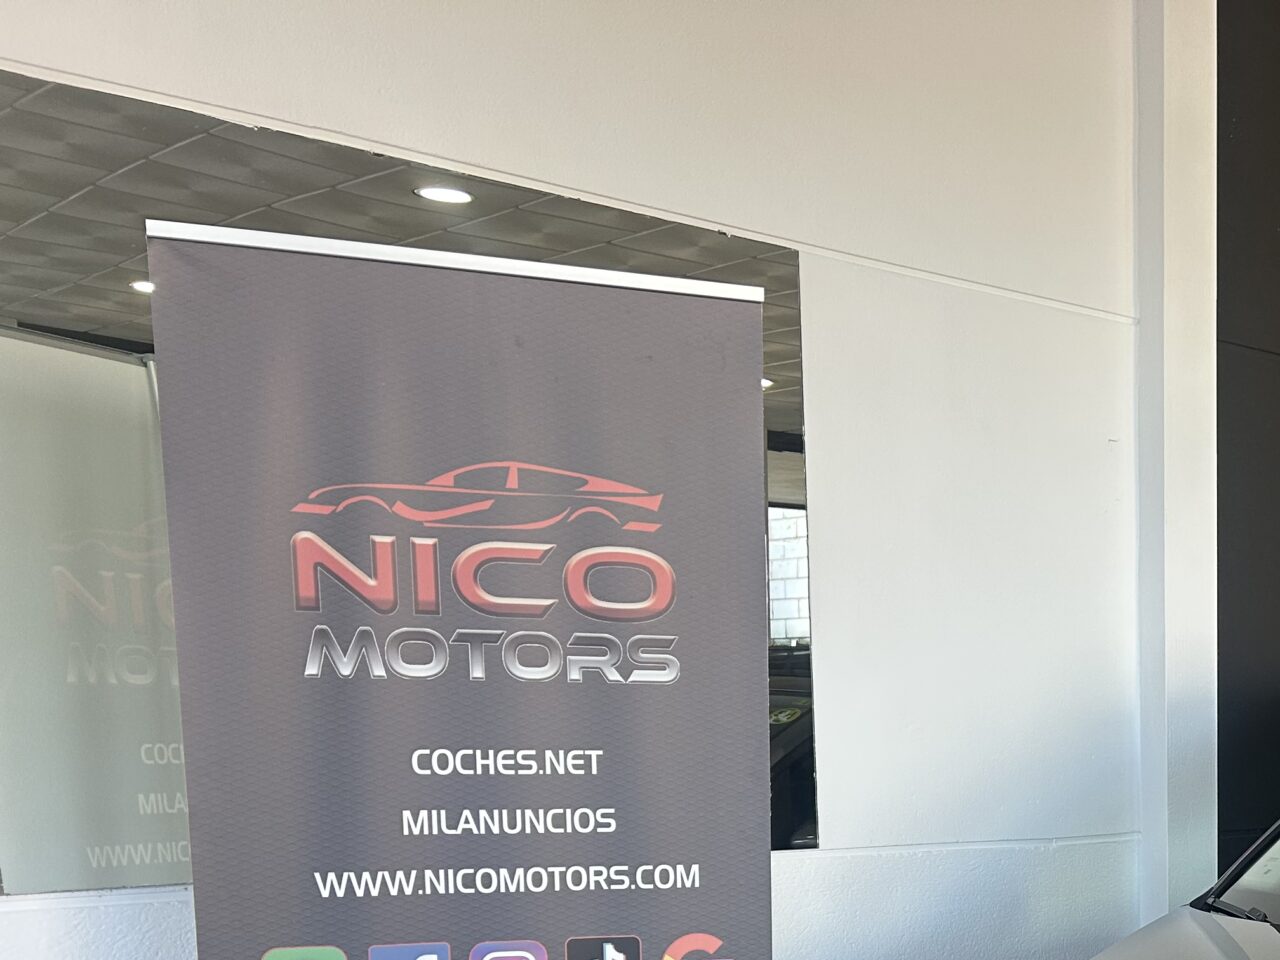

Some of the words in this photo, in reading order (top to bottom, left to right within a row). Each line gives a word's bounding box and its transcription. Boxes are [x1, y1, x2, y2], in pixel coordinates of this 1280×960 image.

[290, 530, 677, 624] NICO
[304, 625, 680, 685] MOTORS
[140, 743, 185, 765] COC
[411, 748, 603, 776] COCHES.NET
[401, 807, 617, 836] MILANUNCIOS
[313, 863, 700, 898] WWW.NICOMOTORS.COM
